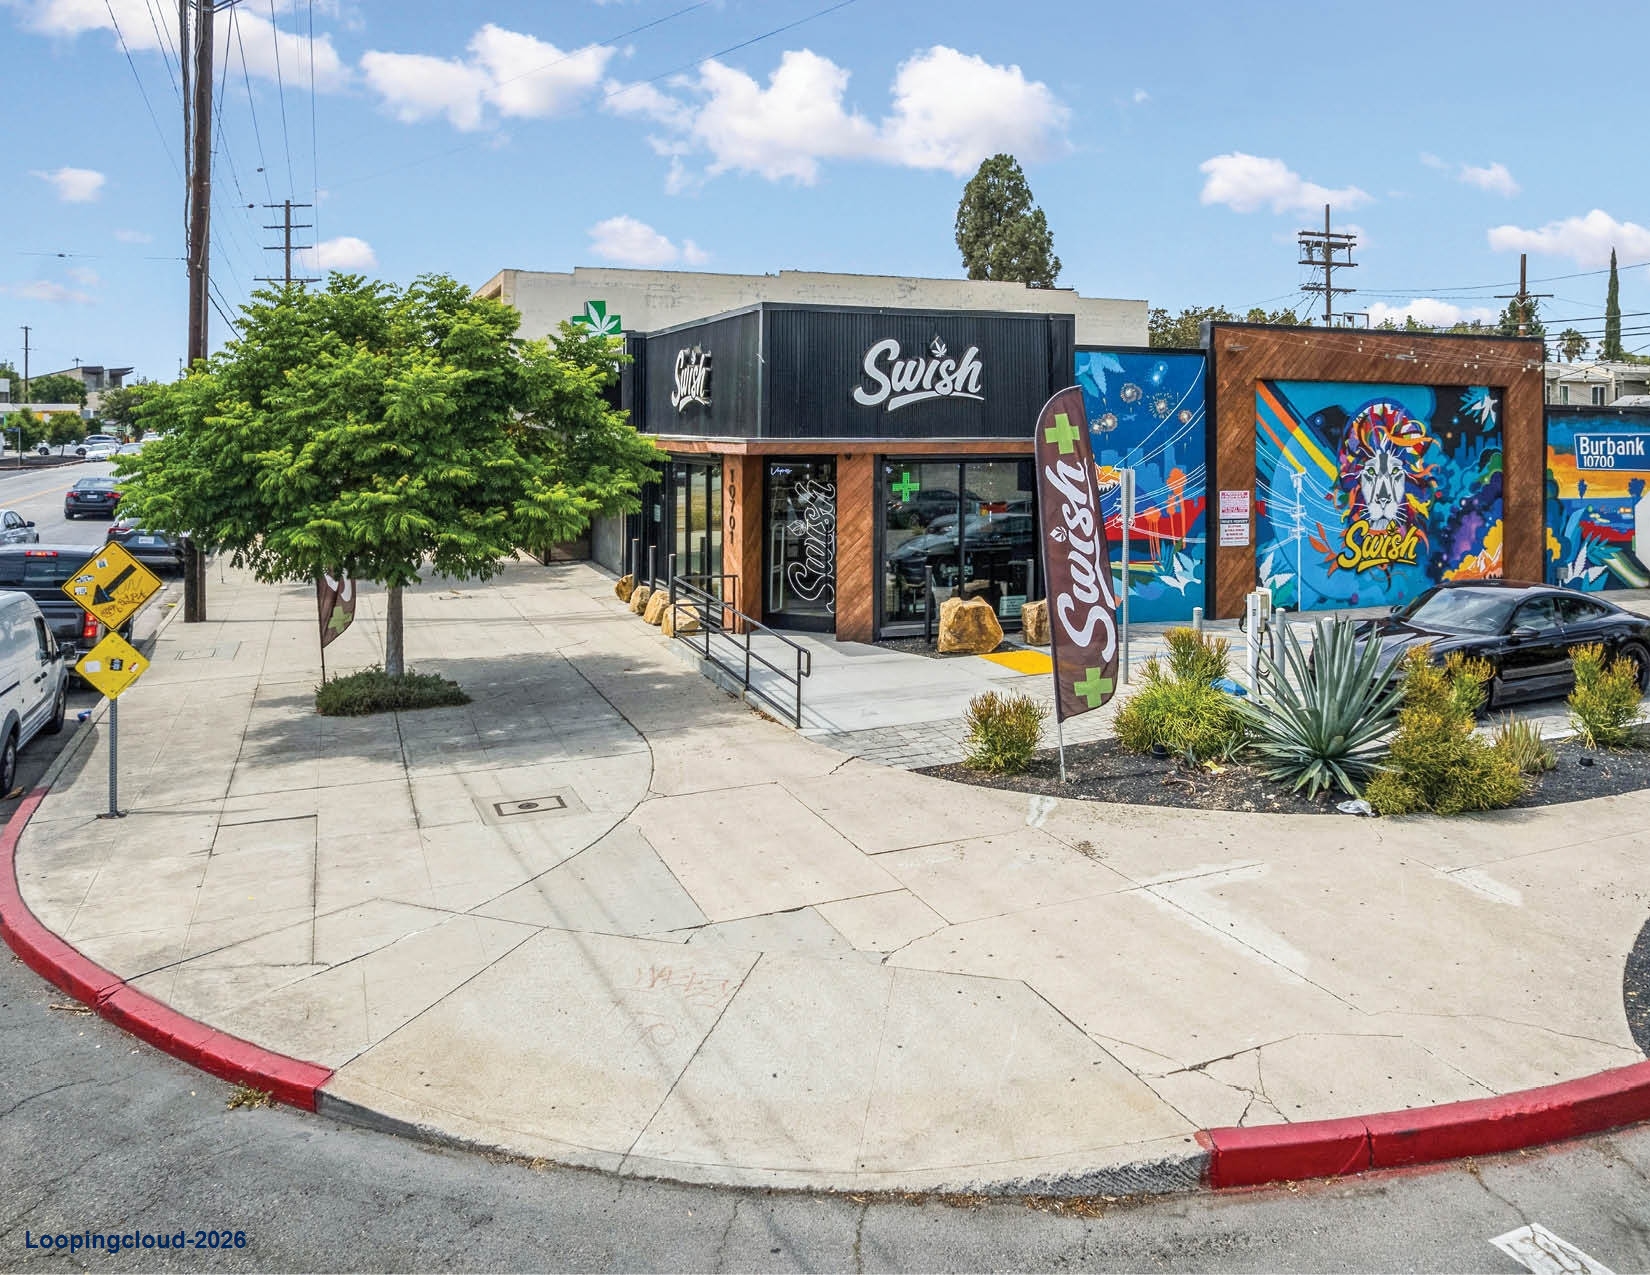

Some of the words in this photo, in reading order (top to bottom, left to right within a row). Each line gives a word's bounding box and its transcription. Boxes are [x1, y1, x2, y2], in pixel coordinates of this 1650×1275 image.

[672, 348, 709, 412] Swish
[854, 339, 984, 411] Swish
[1580, 436, 1645, 456] Burbank
[1583, 455, 1615, 468] 10700
[728, 469, 737, 545] 10701
[788, 480, 836, 614] Swish
[1045, 457, 1118, 663] Swish
[1337, 519, 1419, 573] Swish
